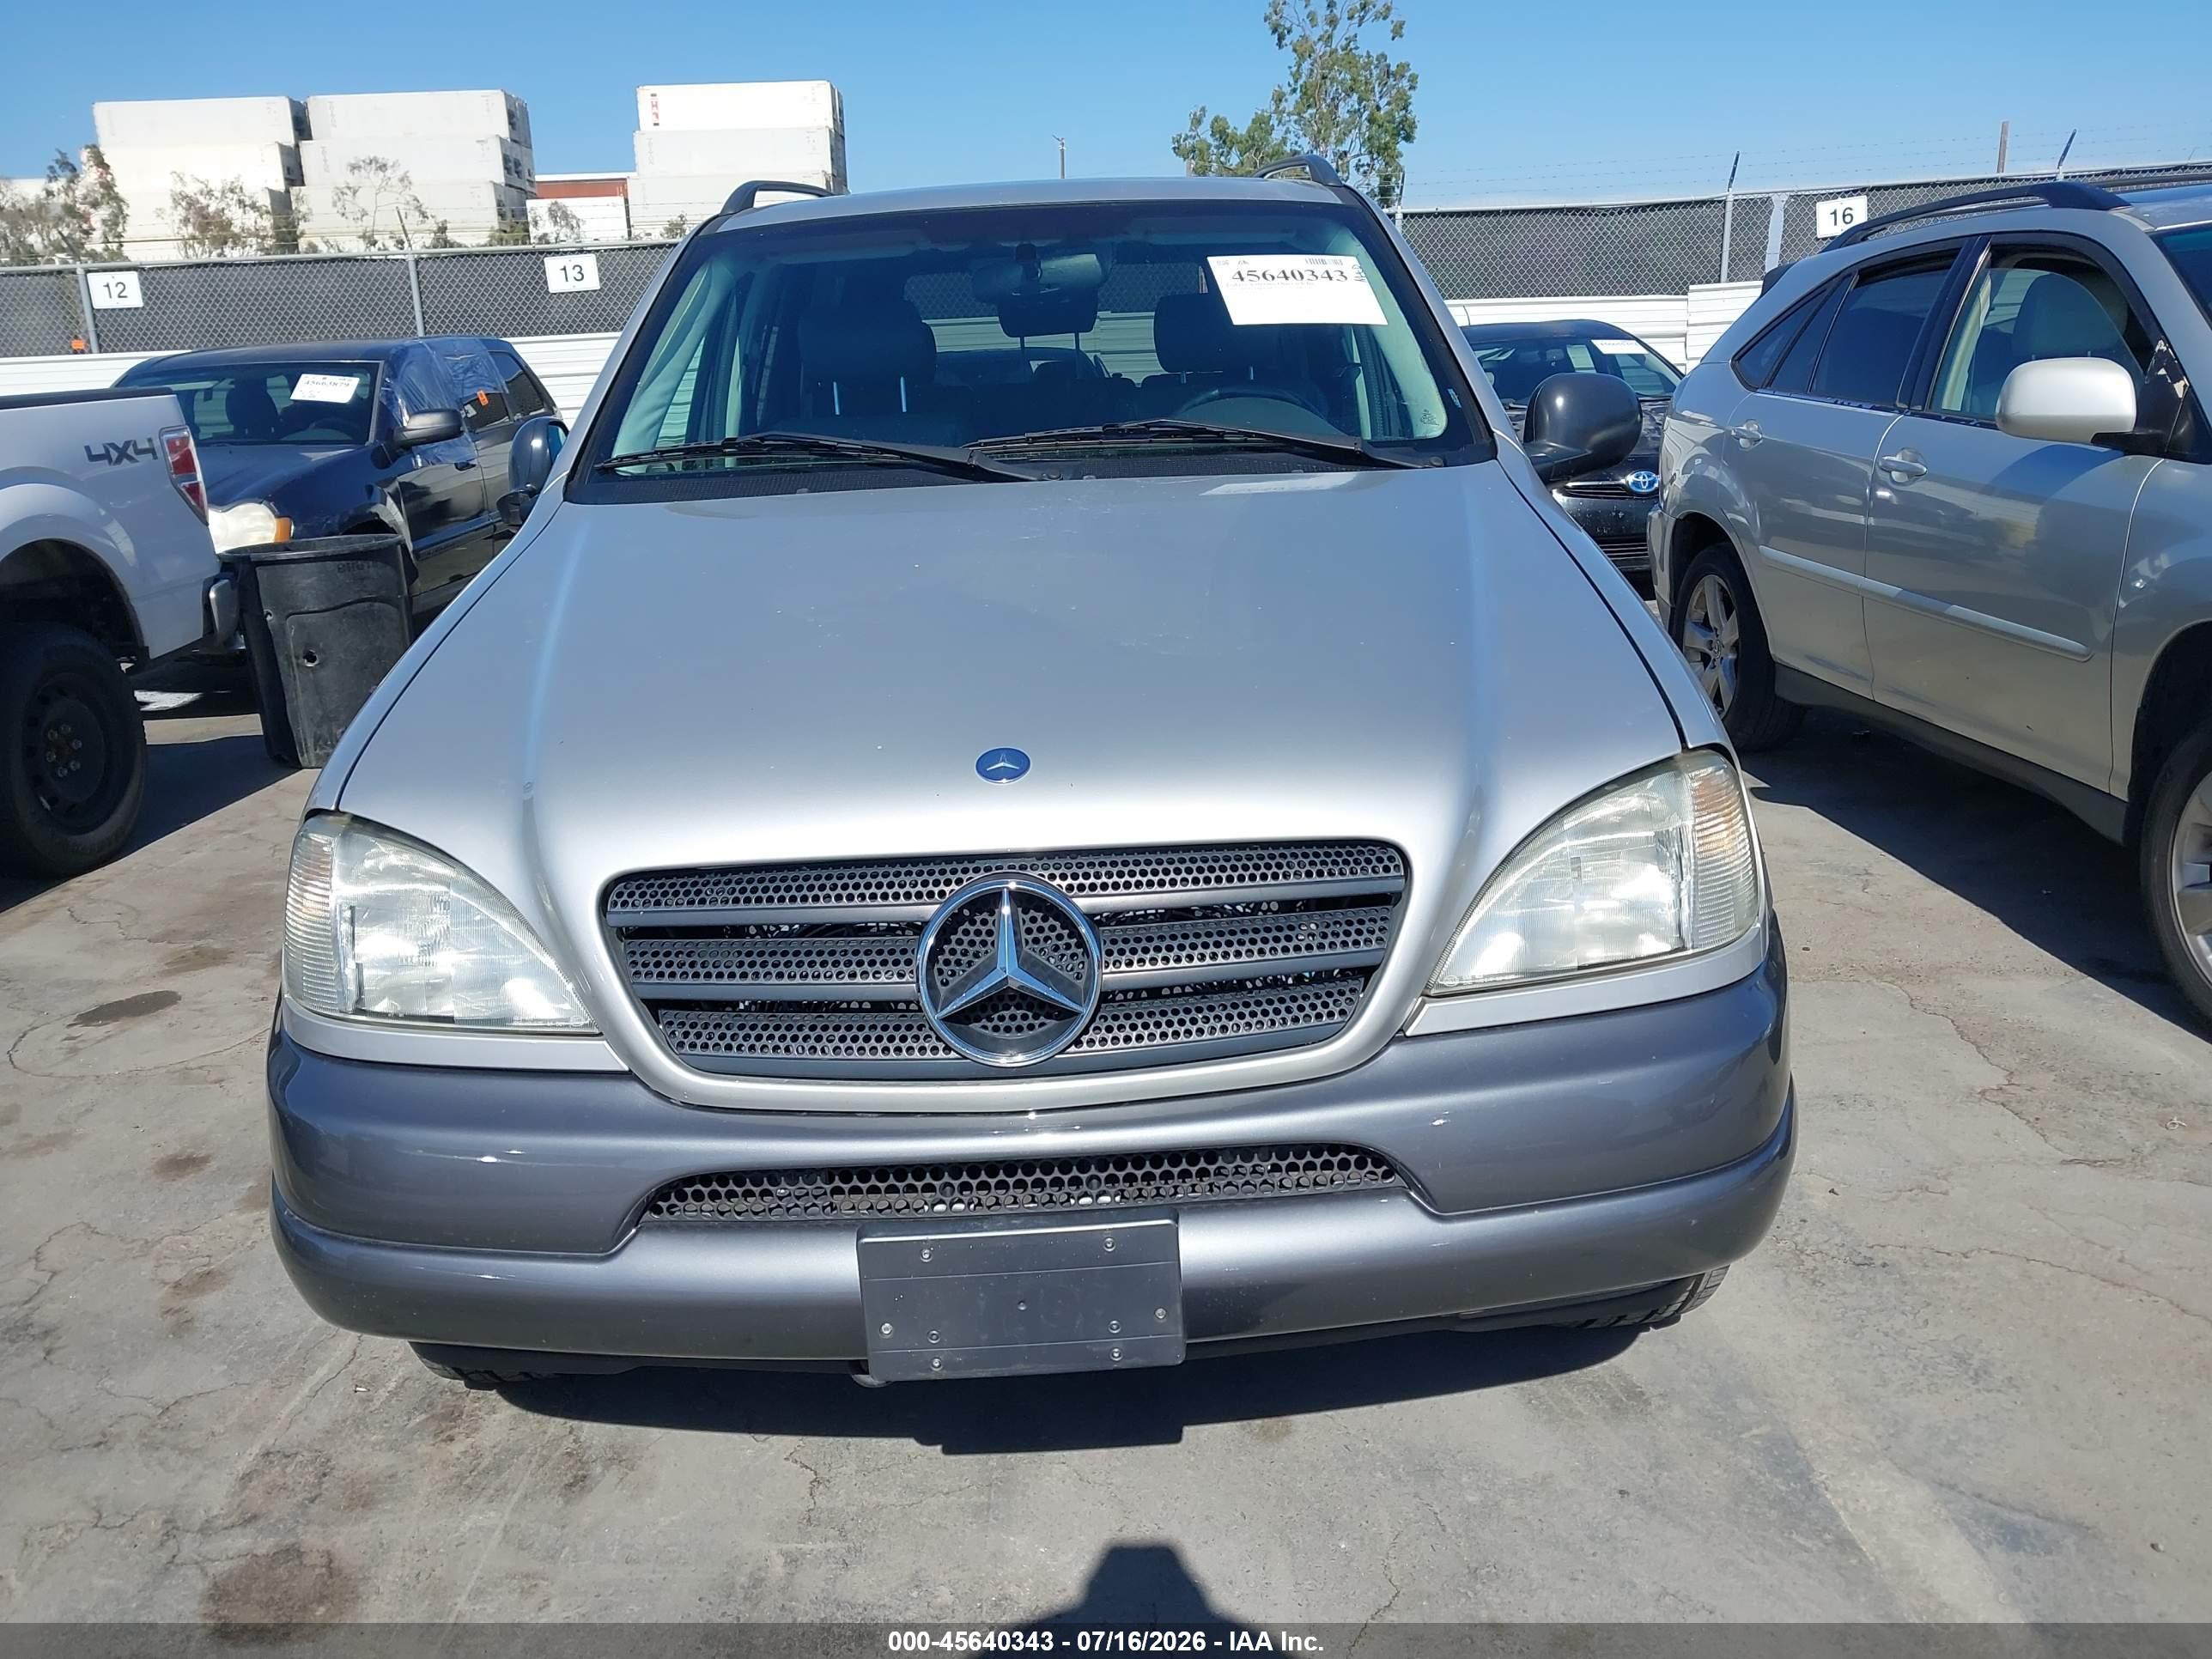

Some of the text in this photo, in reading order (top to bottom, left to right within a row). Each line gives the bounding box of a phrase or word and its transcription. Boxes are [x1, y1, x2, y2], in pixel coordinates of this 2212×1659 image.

[1830, 207, 1854, 226] 16
[559, 264, 585, 282] 13
[1231, 269, 1348, 283] 45640343
[102, 282, 128, 298] 12
